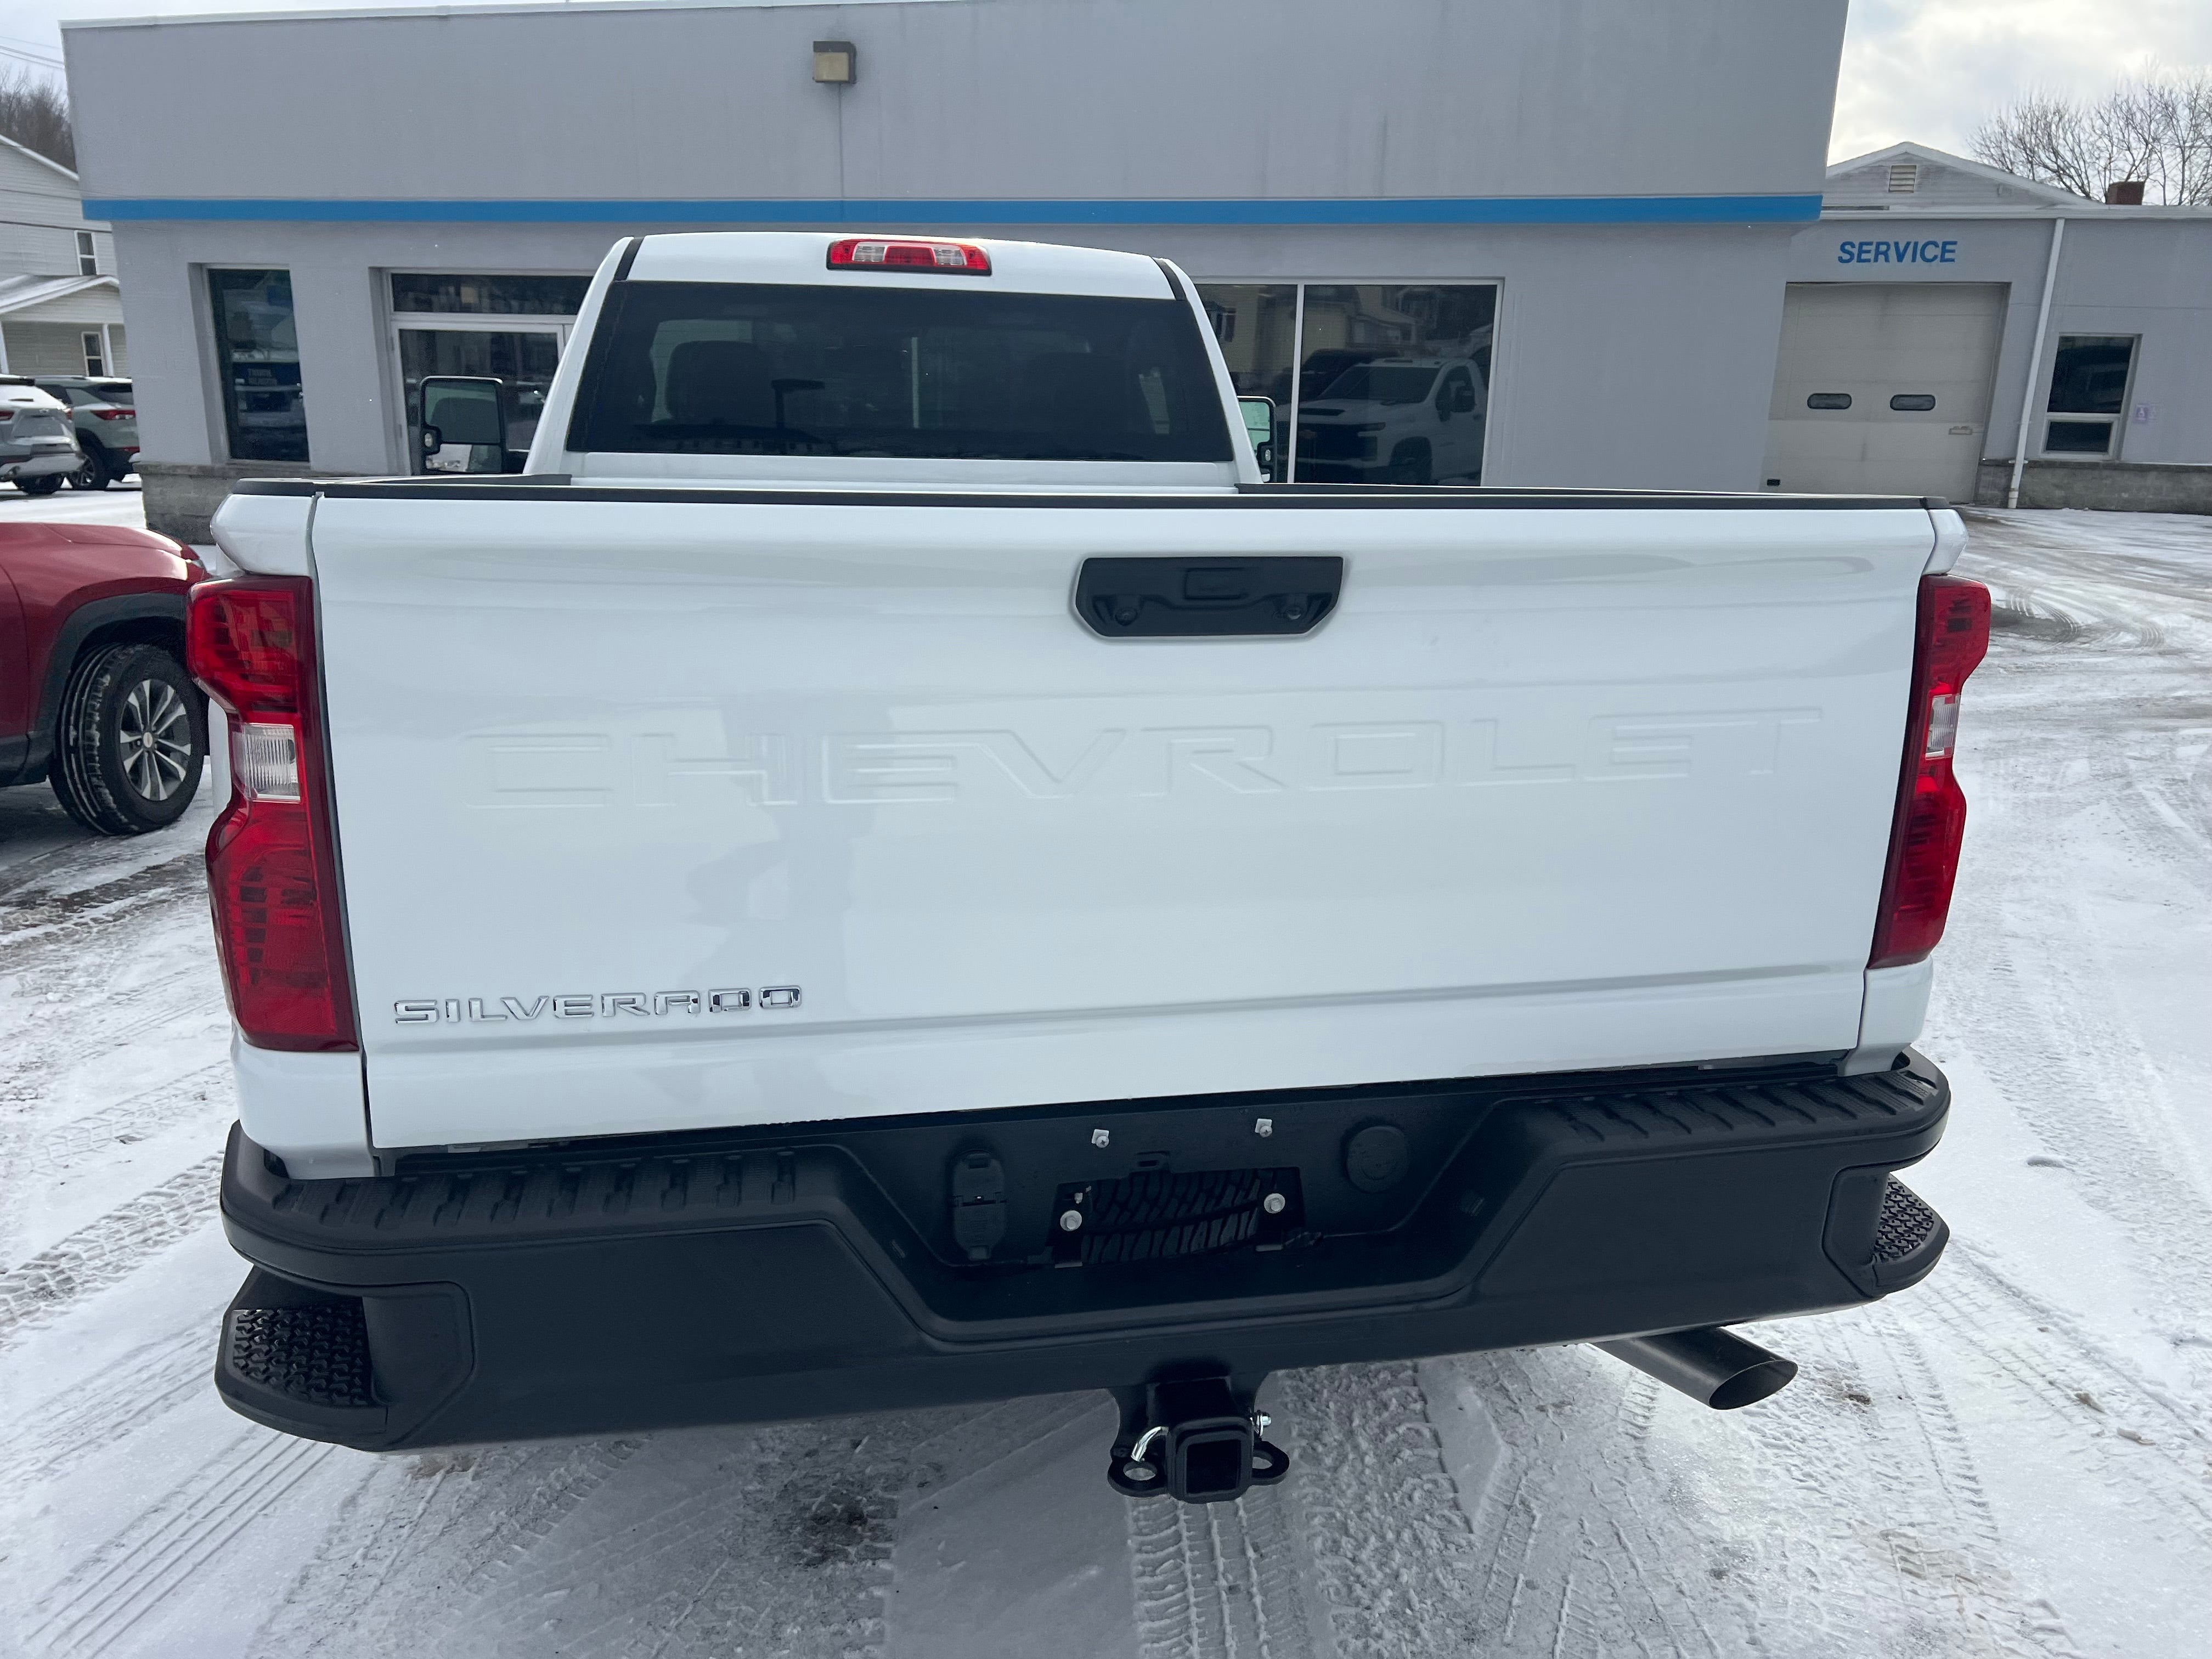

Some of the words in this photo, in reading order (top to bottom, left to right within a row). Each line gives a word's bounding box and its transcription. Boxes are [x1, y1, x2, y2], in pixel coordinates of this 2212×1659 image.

[1838, 240, 1958, 264] SERVICE
[460, 706, 1823, 809] CHEVROLET
[394, 985, 802, 1024] SILVERADO
